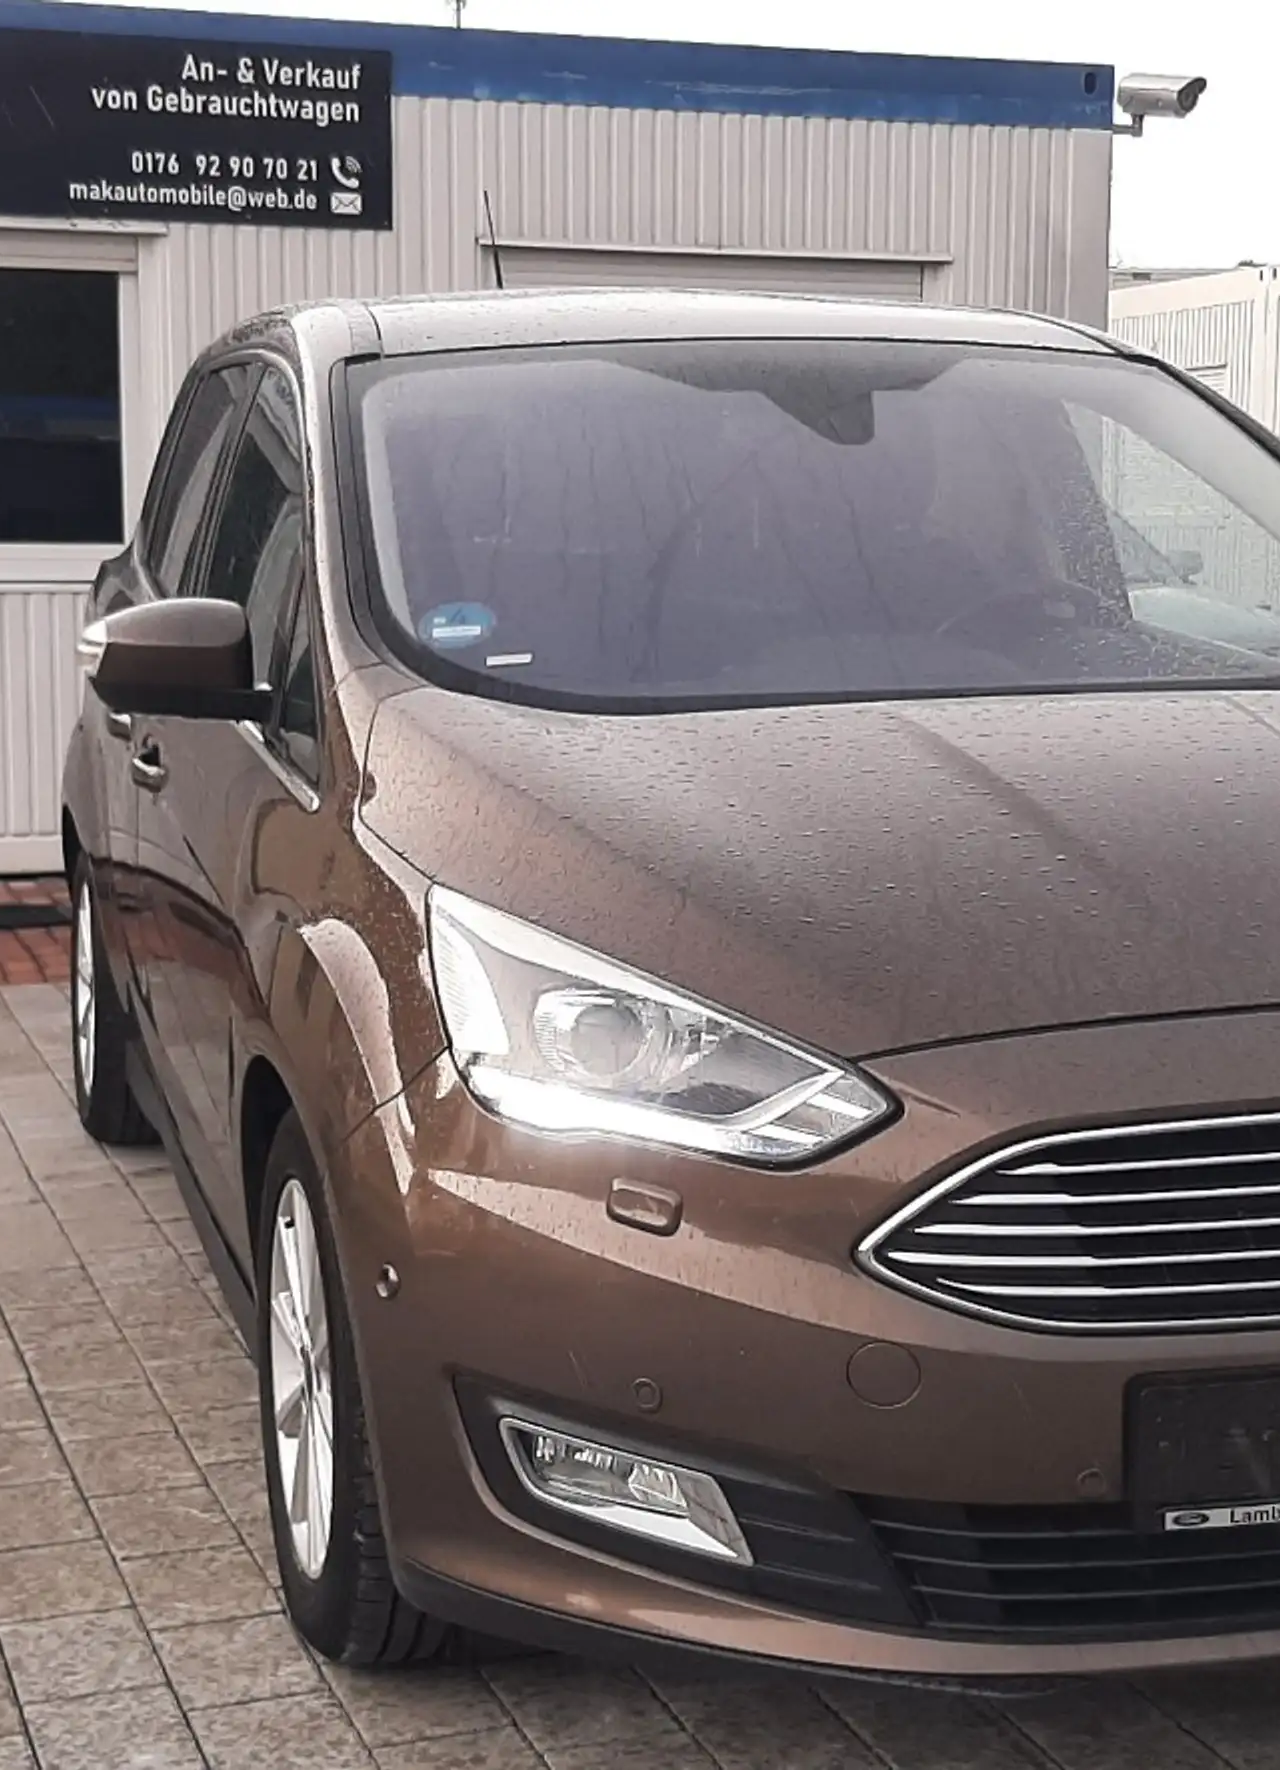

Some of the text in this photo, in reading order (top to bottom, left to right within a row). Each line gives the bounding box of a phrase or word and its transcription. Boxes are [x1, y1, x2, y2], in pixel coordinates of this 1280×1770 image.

[181, 54, 361, 89] An- & Verkauf
[91, 86, 360, 127] von Gebrauchtwagen
[131, 151, 318, 180] 0176 92 90 70 21
[69, 180, 318, 212] makautomobile@web.de
